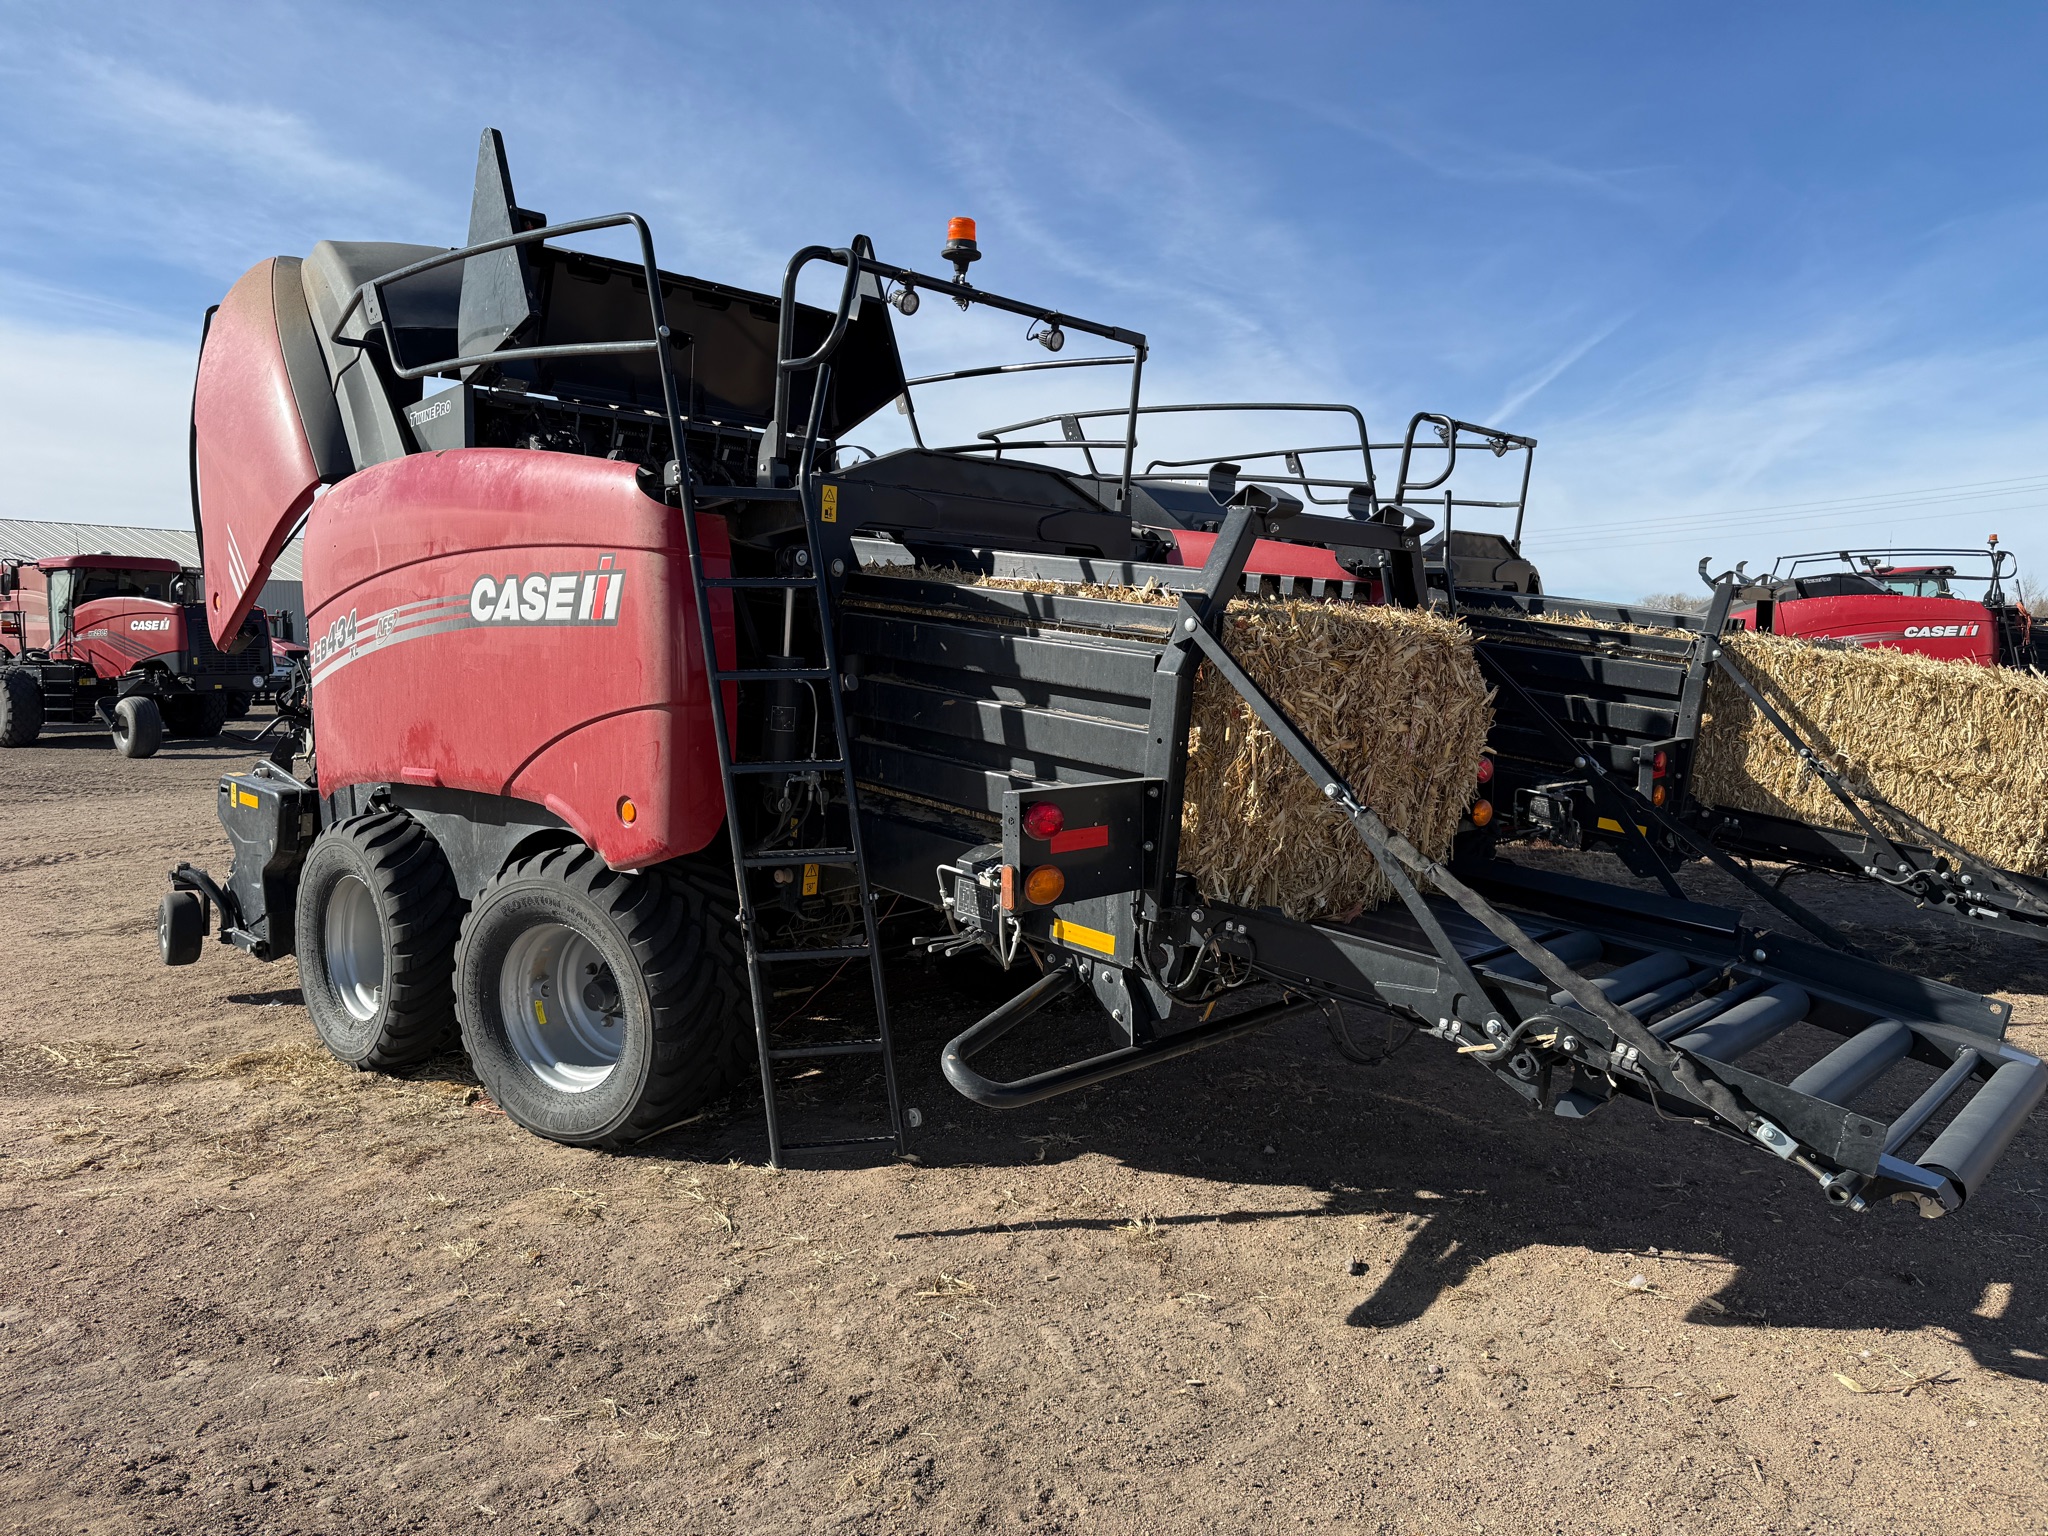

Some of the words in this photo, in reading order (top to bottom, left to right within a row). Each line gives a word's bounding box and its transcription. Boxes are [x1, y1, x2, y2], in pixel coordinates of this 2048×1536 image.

[471, 575, 578, 622] CASE
[131, 620, 159, 630] CASE
[1904, 625, 1958, 638] CASE
[314, 608, 357, 664] LB434
[350, 644, 358, 659] XL
